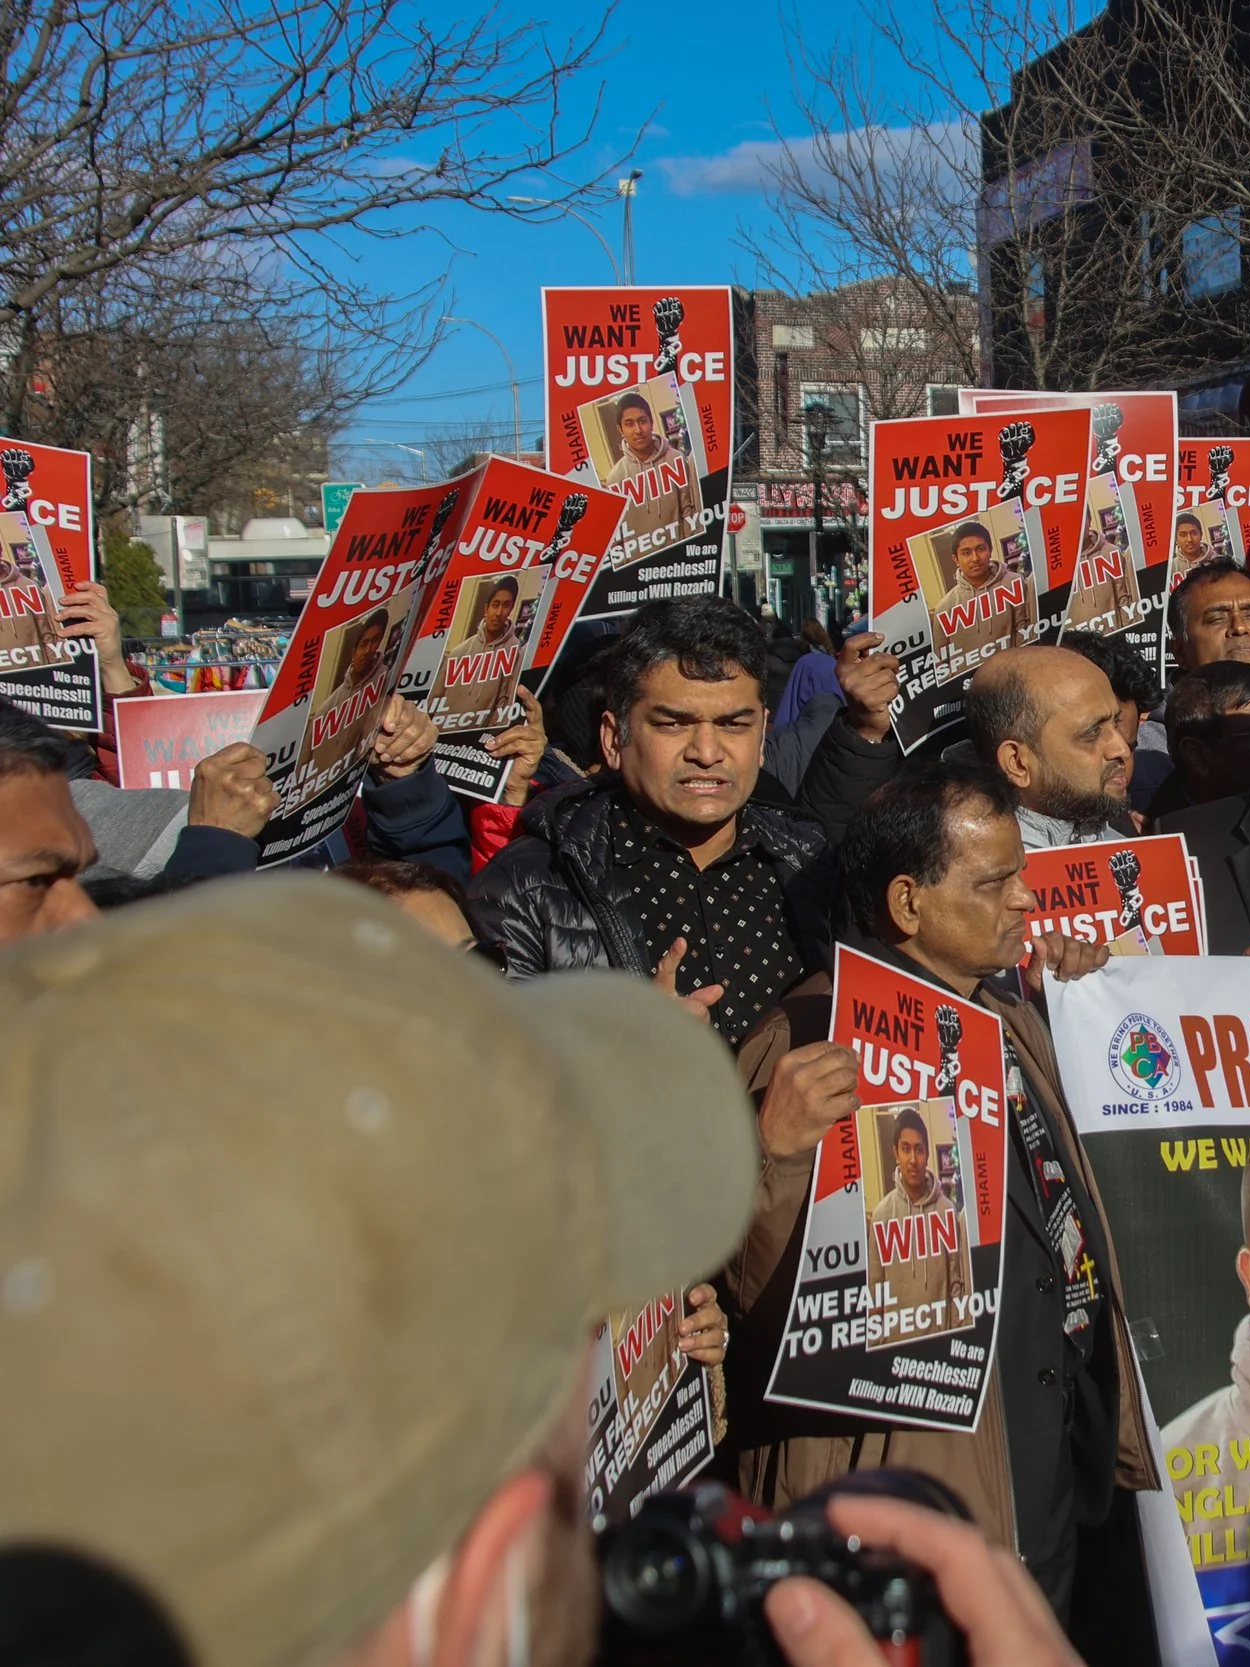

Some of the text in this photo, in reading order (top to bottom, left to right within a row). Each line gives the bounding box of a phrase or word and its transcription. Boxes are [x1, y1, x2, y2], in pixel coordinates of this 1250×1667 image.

[609, 304, 640, 322] WE
[563, 325, 641, 349] WANT
[561, 410, 588, 472] SHAME
[702, 404, 718, 453] SHAME
[947, 432, 983, 451] WE
[610, 455, 688, 507] WIN
[892, 453, 983, 480] WANT
[401, 504, 431, 527] WE
[482, 496, 549, 534] WANT
[528, 487, 556, 511] WE
[685, 501, 728, 532] YOU
[1141, 503, 1158, 547] SHAME
[345, 528, 421, 563] WANT
[1048, 525, 1062, 571] SHAME
[637, 560, 716, 581] speechless!!!
[649, 579, 715, 598] WIN Rozario
[888, 542, 917, 603] SHAME
[431, 579, 459, 638] SHAME
[938, 578, 1025, 637] WIN
[1121, 592, 1169, 620] YOU
[541, 602, 562, 648] SHAME
[47, 638, 97, 660] YOU
[445, 644, 519, 688] WIN
[907, 635, 1011, 700] RESPECT
[1019, 610, 1067, 641] YOU
[913, 644, 962, 676] FAIL
[293, 635, 321, 707] SHAME
[311, 674, 386, 750] WIN
[1065, 861, 1097, 881] WE
[853, 998, 924, 1052] WANT
[897, 991, 924, 1023] WE
[1111, 1015, 1179, 1068] WE BRING PEOPLE TOGETHER
[1102, 1100, 1193, 1115] SINCE 1984
[1160, 1138, 1218, 1172] WE
[976, 1152, 990, 1216] SHAME
[806, 1240, 860, 1272] YOU
[873, 1208, 958, 1267] WIN
[797, 1281, 898, 1323] WE FAIL
[618, 1289, 675, 1382] WIN
[786, 1288, 1000, 1359] TO RESPECT YOU
[891, 1356, 981, 1389] speechless!!!
[849, 1379, 973, 1416] Killing WIN Rozario
[1165, 1444, 1221, 1480] OR
